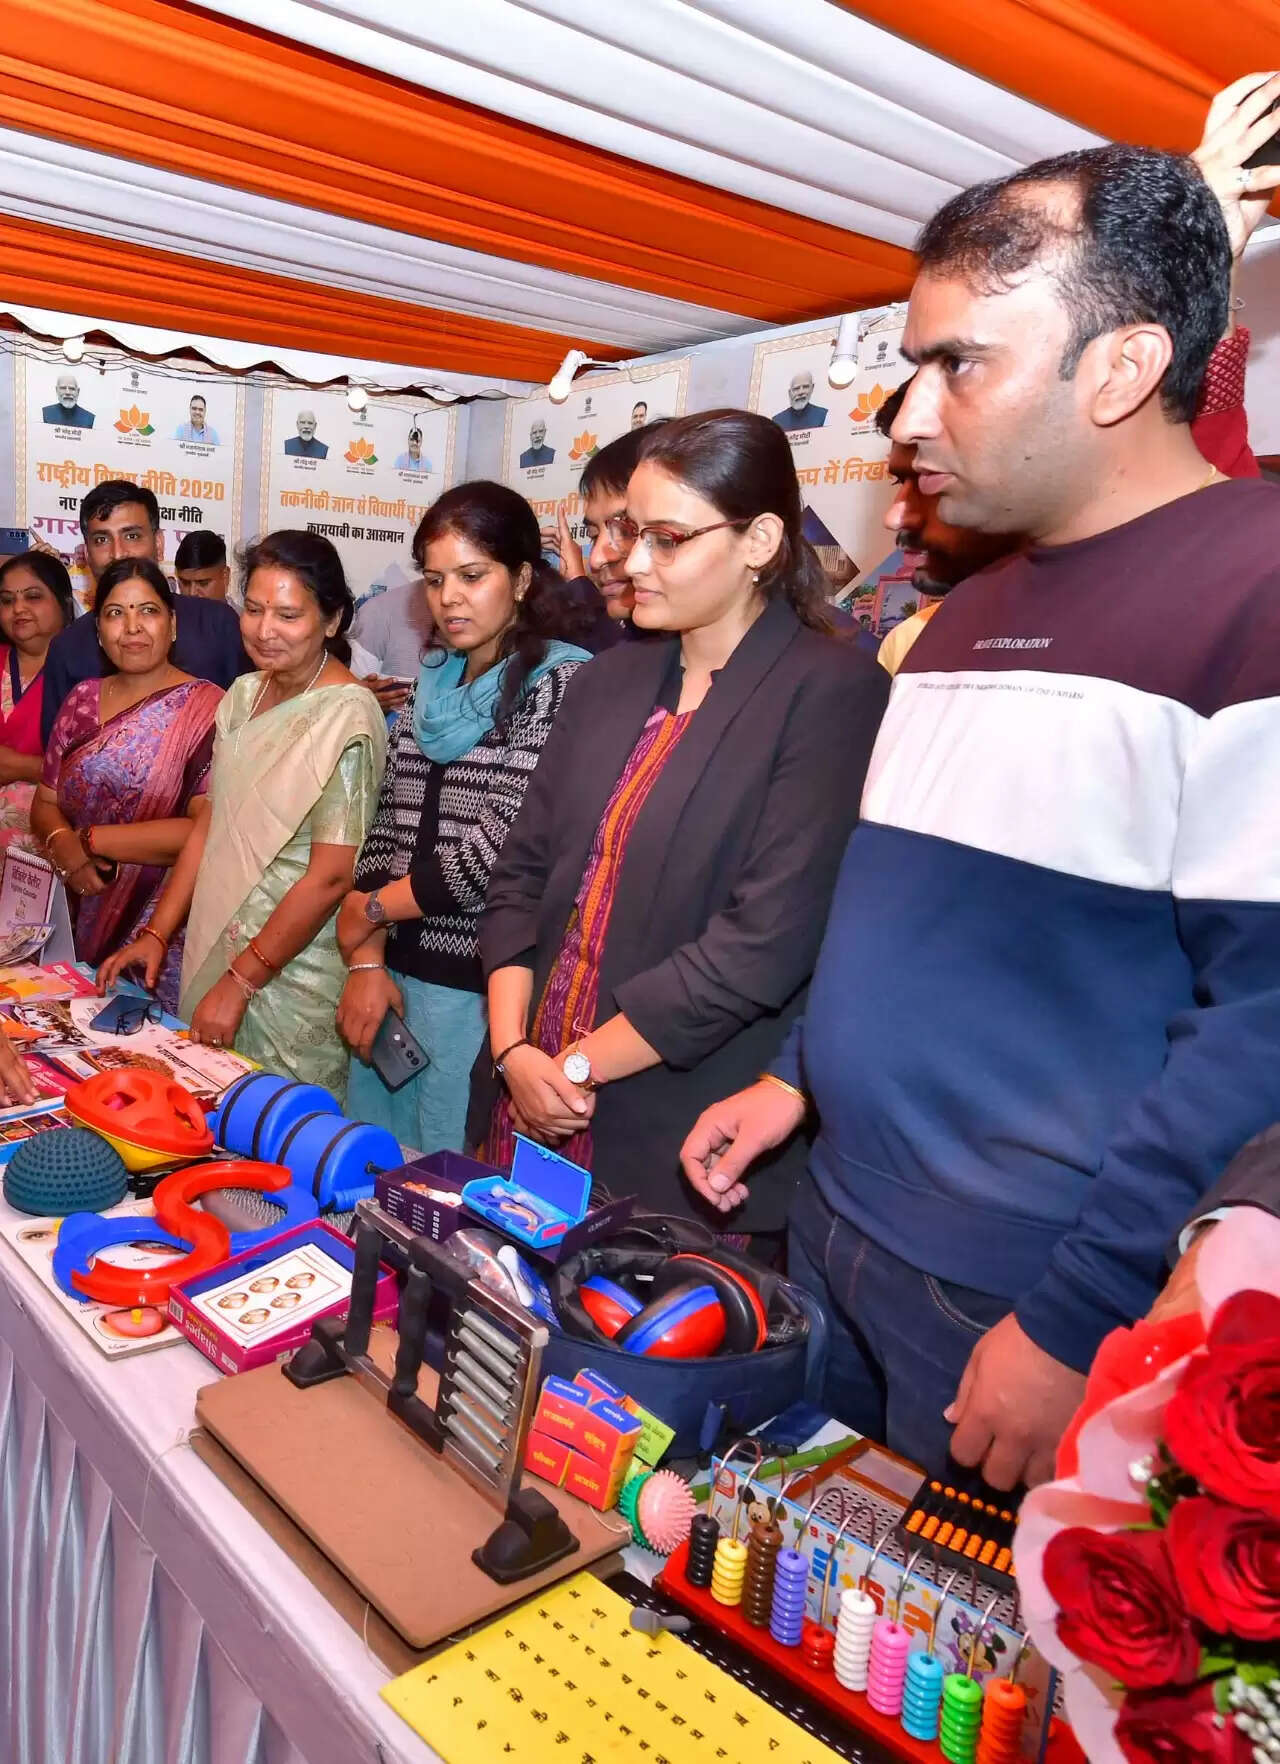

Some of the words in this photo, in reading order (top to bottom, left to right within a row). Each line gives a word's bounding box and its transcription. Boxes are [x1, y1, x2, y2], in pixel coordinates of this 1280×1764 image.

[36, 460, 91, 489] राष्ट्रीय
[180, 478, 225, 501] 2020
[823, 459, 841, 485] में
[842, 457, 889, 484] निख
[59, 496, 78, 511] नए
[178, 505, 204, 524] नीति
[280, 488, 330, 511] तकनीकी
[306, 522, 350, 540] कामयाबी
[351, 526, 365, 541] का
[366, 527, 405, 544] आसमान
[991, 637, 1054, 650] EXPLORATION
